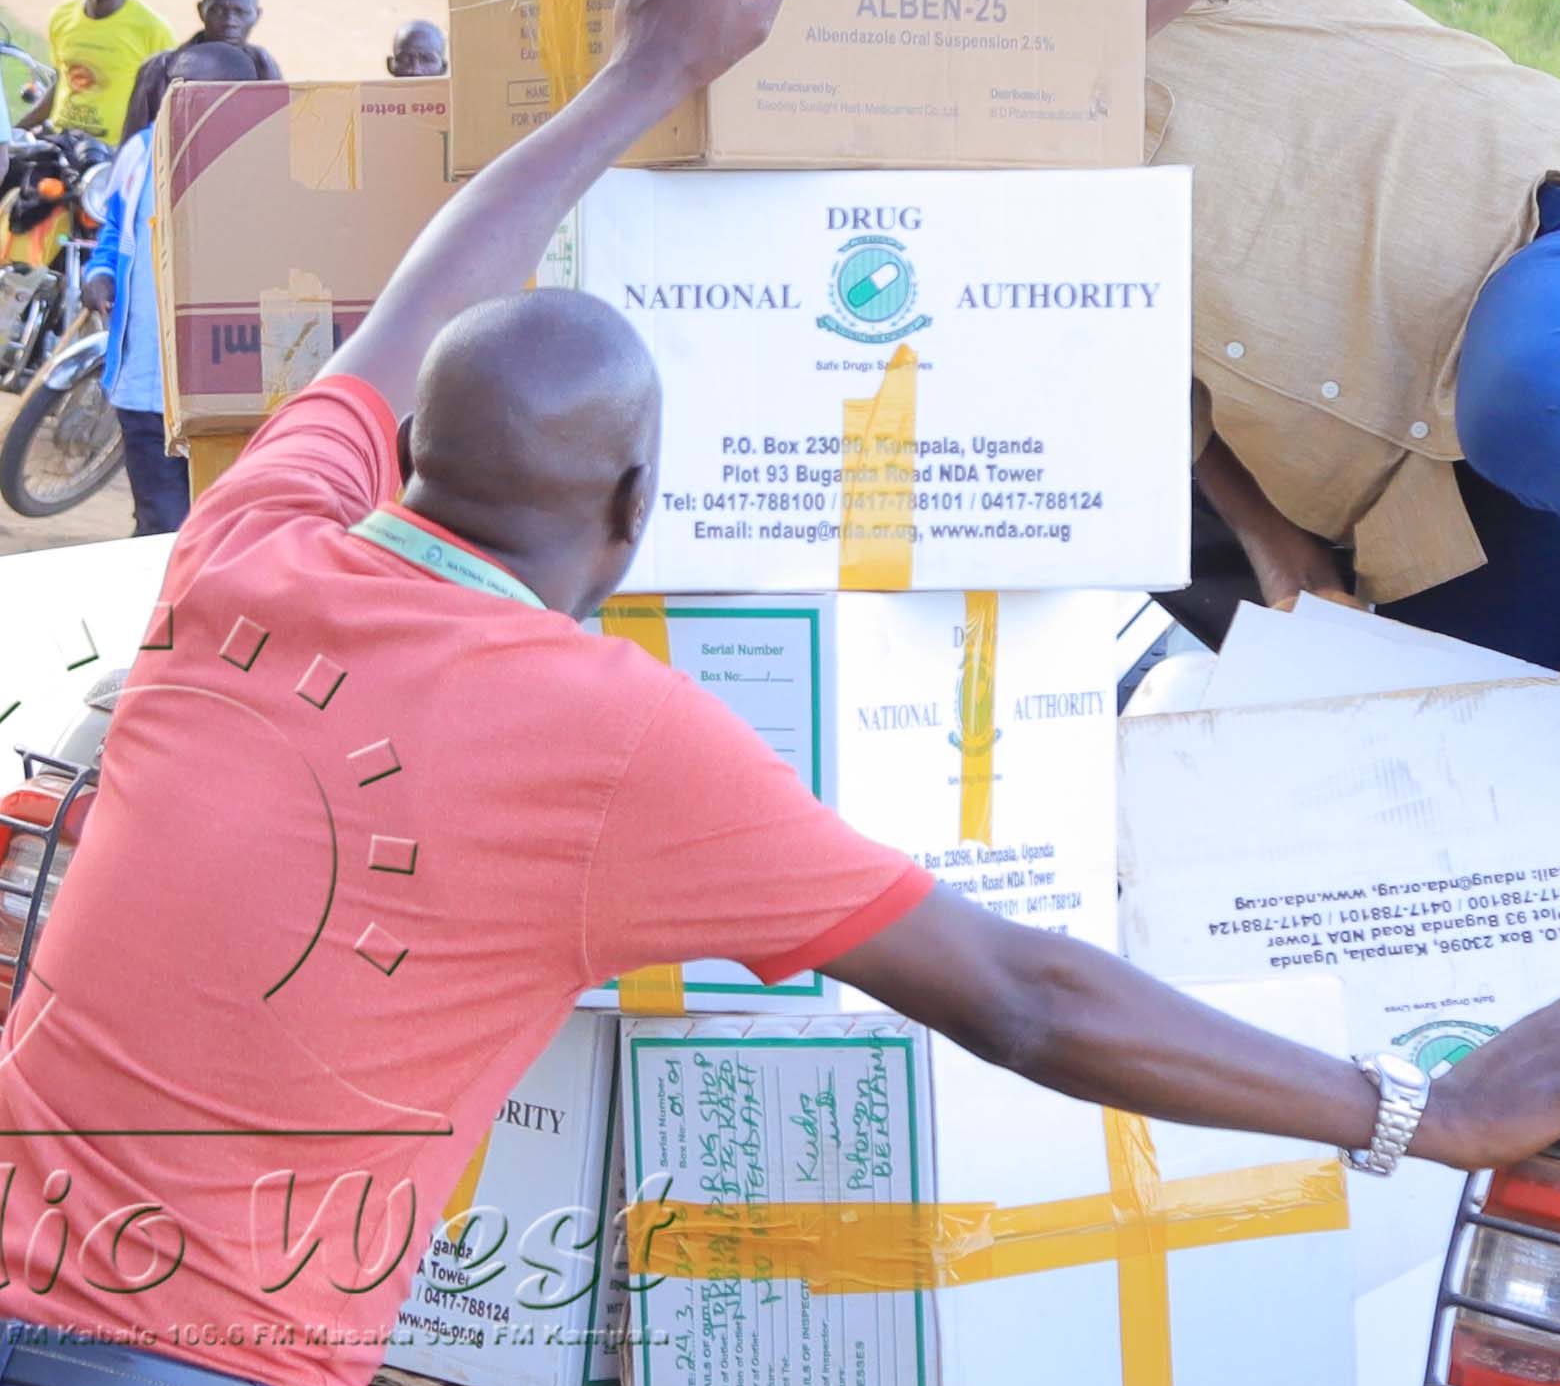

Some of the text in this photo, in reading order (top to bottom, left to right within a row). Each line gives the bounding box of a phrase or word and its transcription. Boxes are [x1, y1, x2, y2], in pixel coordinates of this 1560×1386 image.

[806, 27, 1054, 51] Albendazole Oral Suspension 2.5%
[826, 207, 922, 231] DRUG
[625, 283, 1161, 310] NATIONAL AUTHORITY
[722, 437, 1044, 459] P.O. Box Uganda
[723, 465, 760, 482] Plot
[766, 465, 789, 482] 93
[940, 464, 979, 482] NDA
[987, 465, 1044, 482] Tower
[663, 493, 1103, 510] Tel: 0417-788100 0417-788124
[694, 521, 752, 539] Email:
[930, 522, 1071, 544] www.nda.or.ug
[702, 644, 784, 656] Serial Number
[701, 670, 721, 681] Box
[857, 691, 1106, 731] NATIONAL AUTHORITY
[925, 853, 940, 869] Box
[1022, 843, 1054, 863] Uganda
[982, 870, 1055, 891] Road NDA Tower
[1371, 869, 1525, 898] ndaug@nda.or.ug,
[1235, 887, 1366, 912] www.nda.or.ug
[1338, 898, 1452, 923] 0417-788101
[1505, 911, 1527, 927] 93
[1208, 912, 1322, 935] 0417-788124
[1371, 924, 1415, 940] Road
[1421, 911, 1499, 934] Buganda
[1267, 933, 1321, 950] Tower
[1328, 929, 1364, 944] NDA
[1433, 934, 1492, 954] 23096,
[1500, 930, 1532, 945] Box
[1270, 949, 1338, 969] Uganda
[1343, 942, 1428, 963] Kampala,
[1384, 995, 1495, 1013] Safe Drugs Save Lives
[657, 1077, 668, 1167] Serial Number
[678, 1147, 688, 1169] Box
[425, 1287, 510, 1324] 0417-788124
[701, 1286, 711, 1337] OUTLET
[703, 1341, 711, 1358] OF
[720, 1334, 728, 1369] Outlet:
[751, 1331, 759, 1366] Outlet:
[802, 1344, 810, 1361] OF
[821, 1319, 831, 1373] Inspector:
[735, 1355, 743, 1366] of
[721, 1371, 728, 1382] of
[752, 1368, 760, 1380] of
[822, 1376, 830, 1386] of
